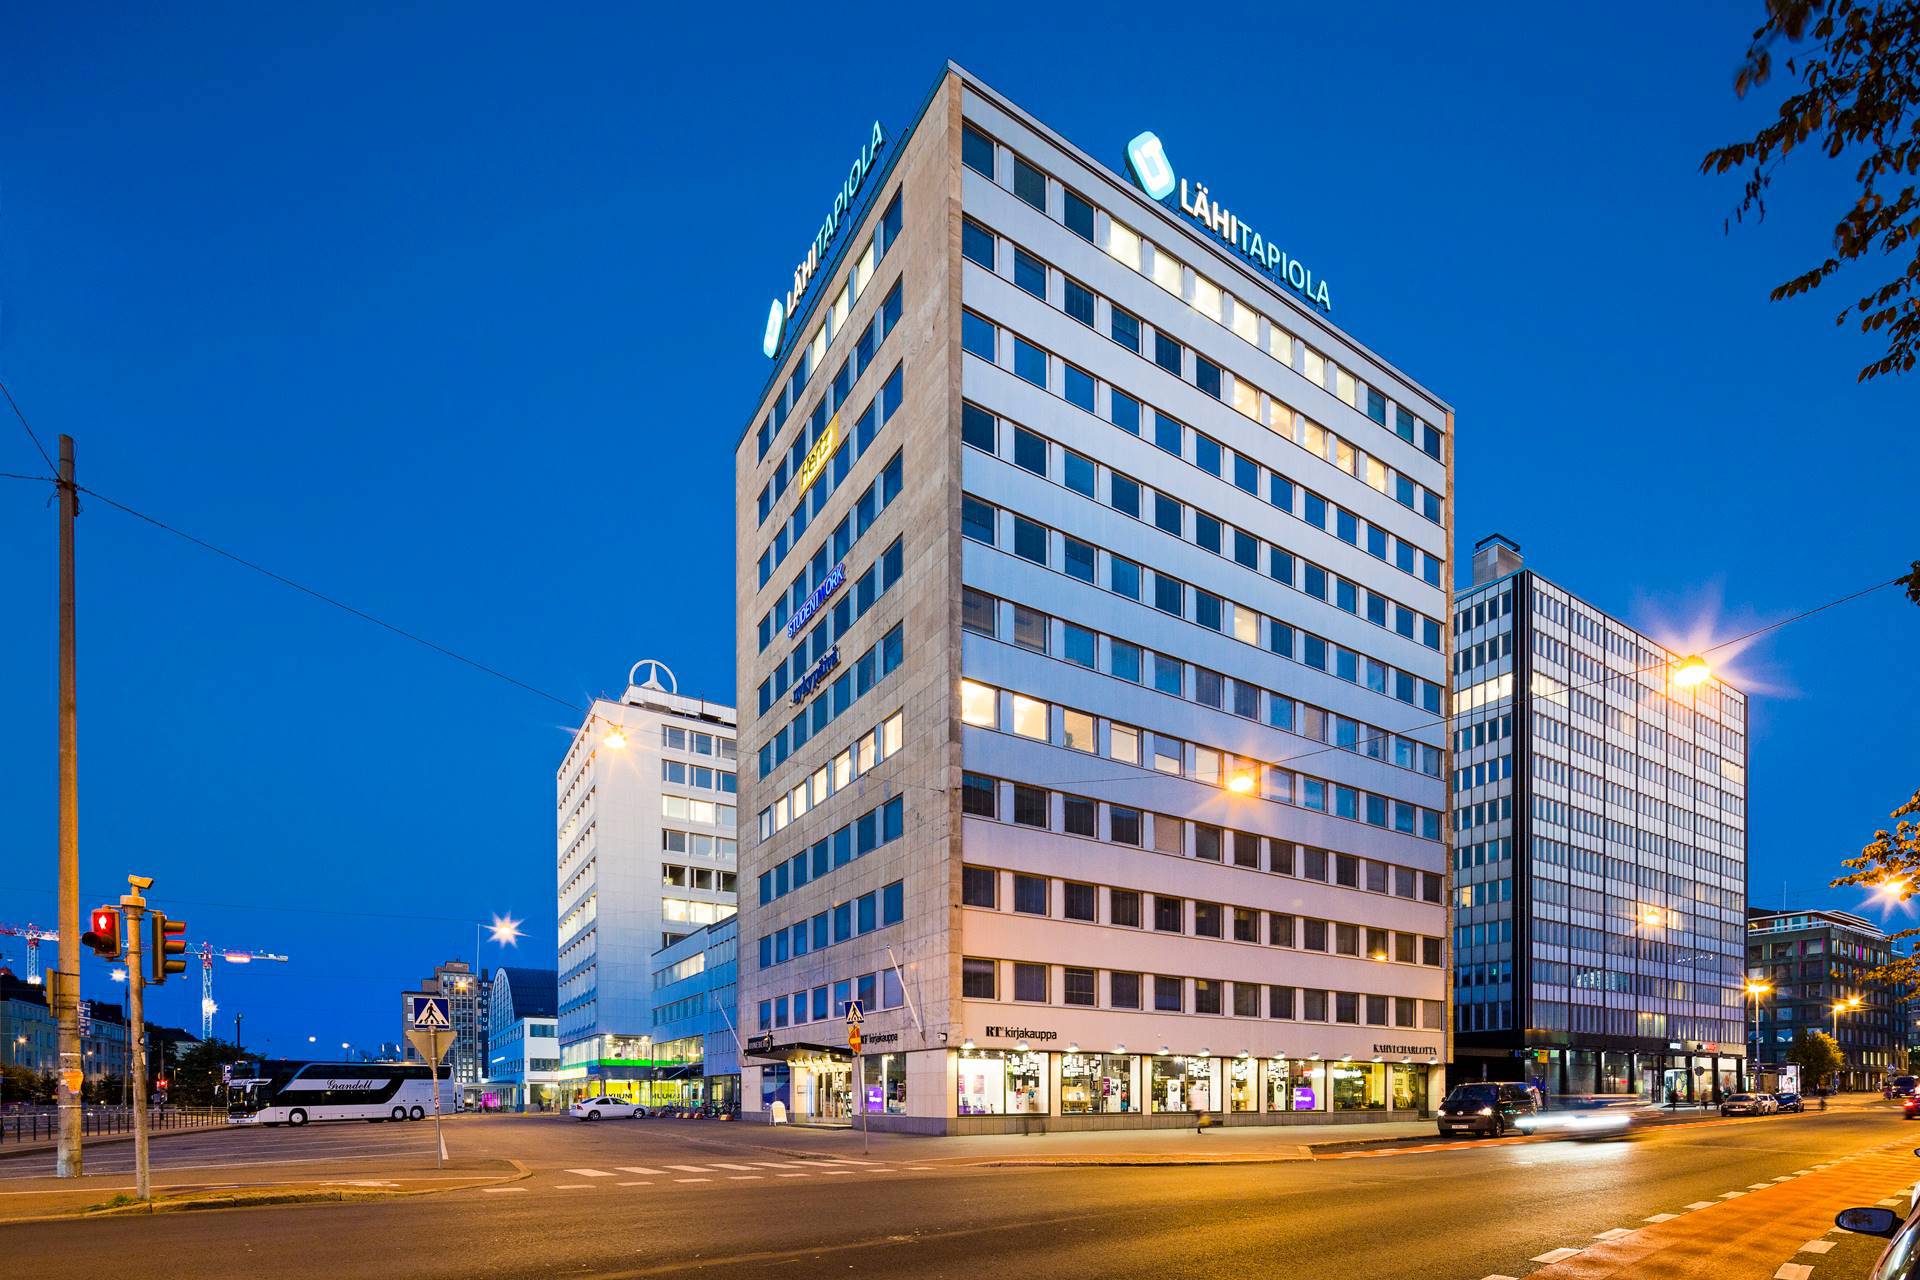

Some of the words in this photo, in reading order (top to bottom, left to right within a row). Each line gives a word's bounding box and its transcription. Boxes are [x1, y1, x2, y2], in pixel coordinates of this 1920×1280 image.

[786, 119, 883, 319] LÄHITAPIOLA
[1180, 177, 1331, 311] LÄHITAPIOLA
[801, 430, 833, 487] Hertz
[986, 1026, 1001, 1037] RT
[1005, 1026, 1057, 1041] kirjakauppa
[1396, 1045, 1437, 1055] CHARLOTTA
[326, 1079, 373, 1091] Grandell
